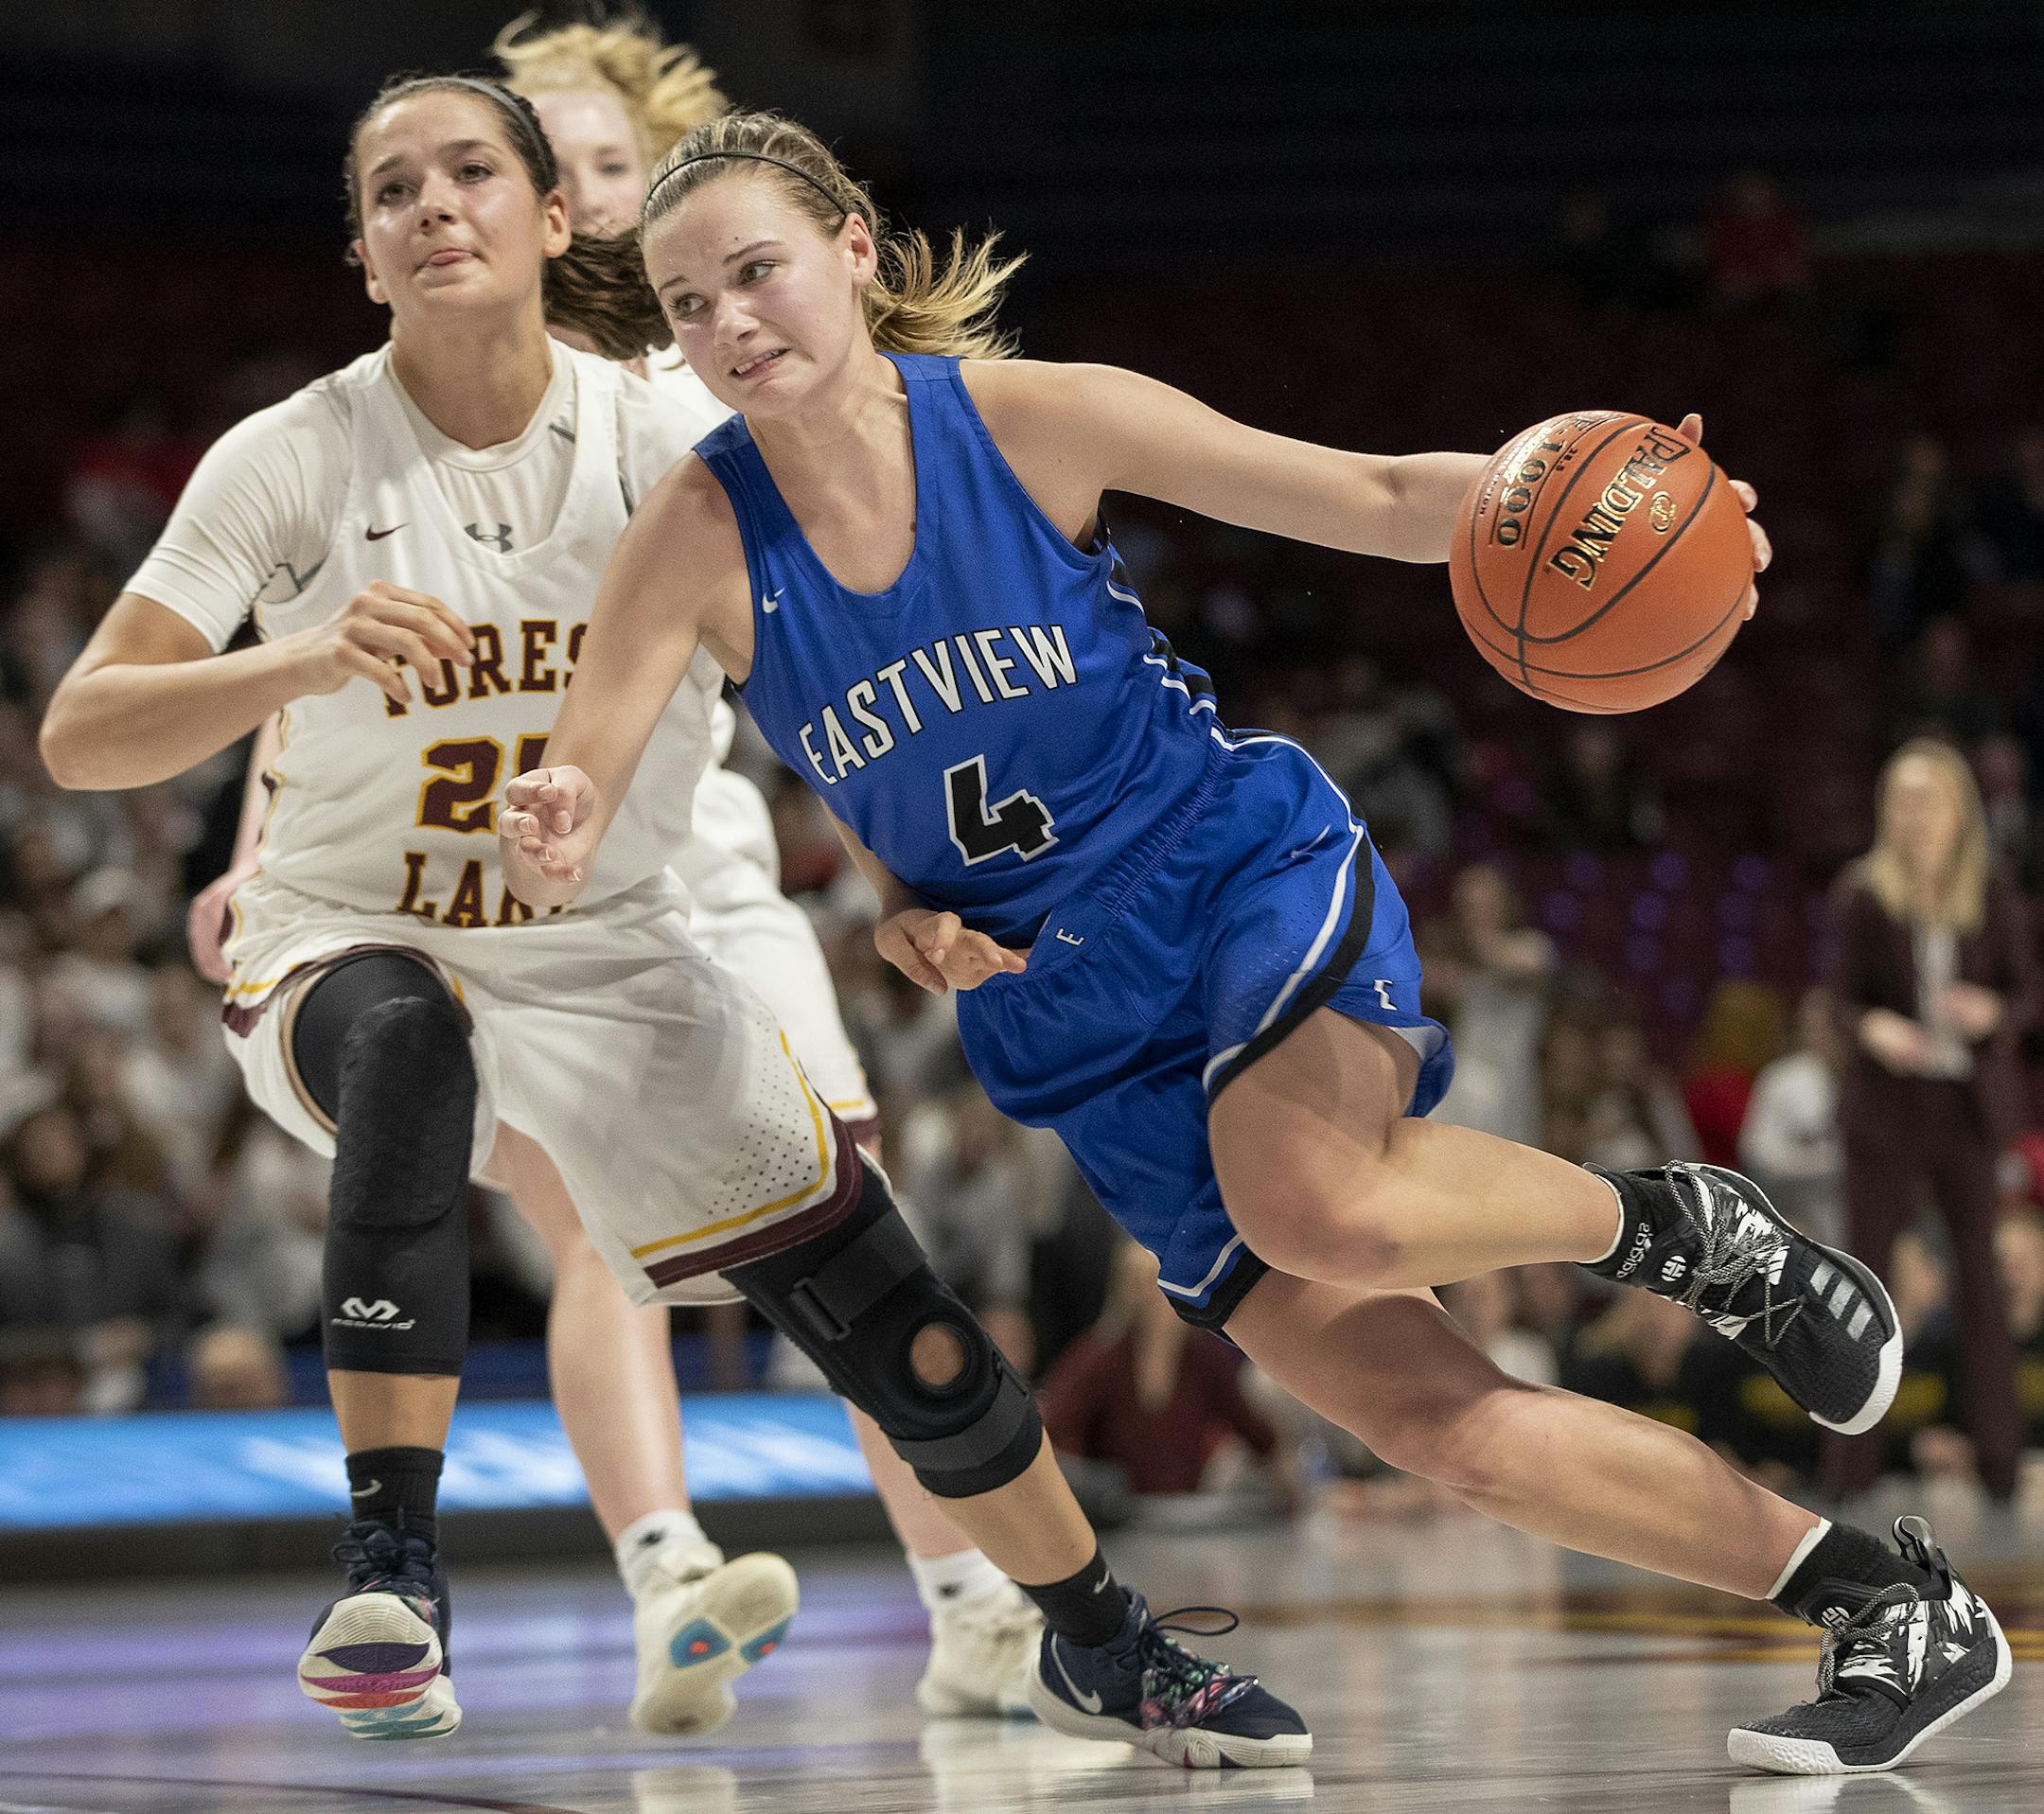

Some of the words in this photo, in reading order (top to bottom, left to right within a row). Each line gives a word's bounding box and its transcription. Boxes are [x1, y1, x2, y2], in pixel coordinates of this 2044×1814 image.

[1548, 425, 1691, 591] PALDING
[798, 624, 1079, 785] EASTVIEW
[415, 732, 551, 837] 2
[943, 754, 1060, 867] 4
